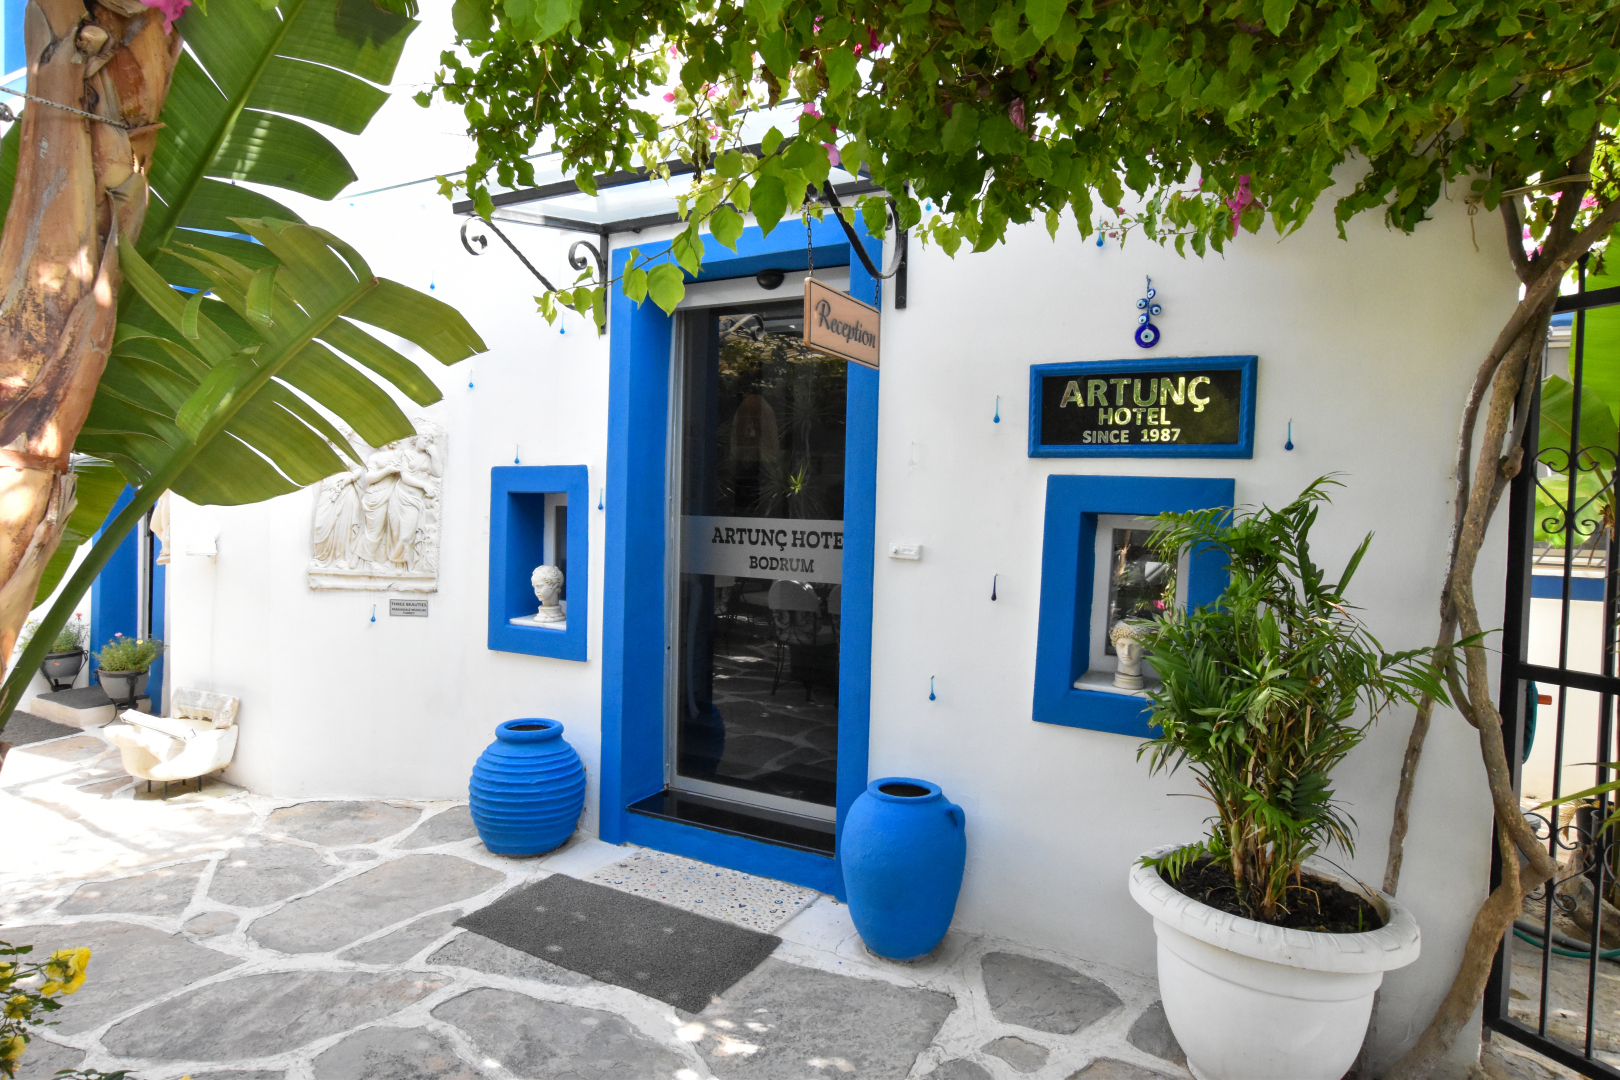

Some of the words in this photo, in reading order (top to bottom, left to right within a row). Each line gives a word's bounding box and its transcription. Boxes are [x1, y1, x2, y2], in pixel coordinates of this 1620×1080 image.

[815, 299, 876, 349] Reception
[1059, 375, 1211, 413] ARTUNÇ
[1098, 407, 1171, 425] HOTEL
[1082, 430, 1130, 443] SINCE
[1140, 428, 1181, 442] 1987
[711, 526, 787, 551] ARTUNÇ
[791, 530, 843, 550] HOTE
[749, 555, 815, 573] BODRUM
